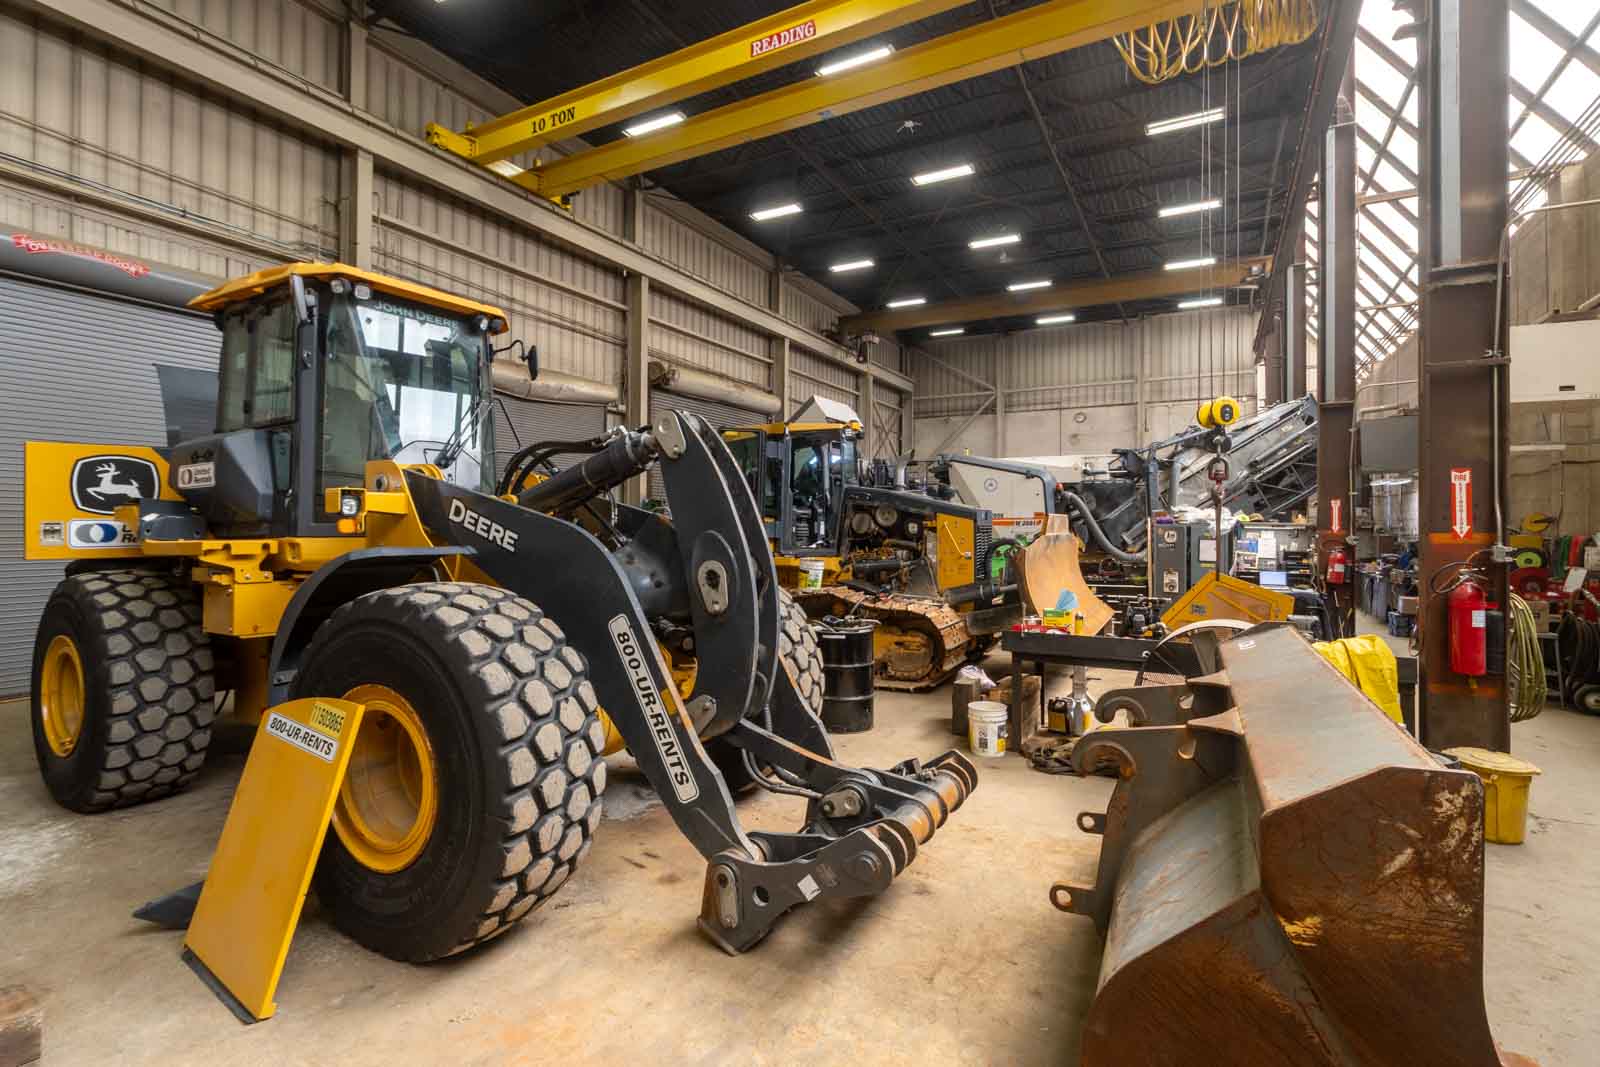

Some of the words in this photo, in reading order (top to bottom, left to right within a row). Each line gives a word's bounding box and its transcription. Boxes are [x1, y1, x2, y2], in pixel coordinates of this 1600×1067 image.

[752, 21, 814, 57] READING
[532, 118, 546, 133] 10
[551, 106, 576, 126] TON
[374, 302, 414, 318] JOHN
[448, 498, 519, 552] DEERE
[616, 631, 690, 786] 800-UR-RENTS
[270, 717, 334, 756] 800-UR-RENTS
